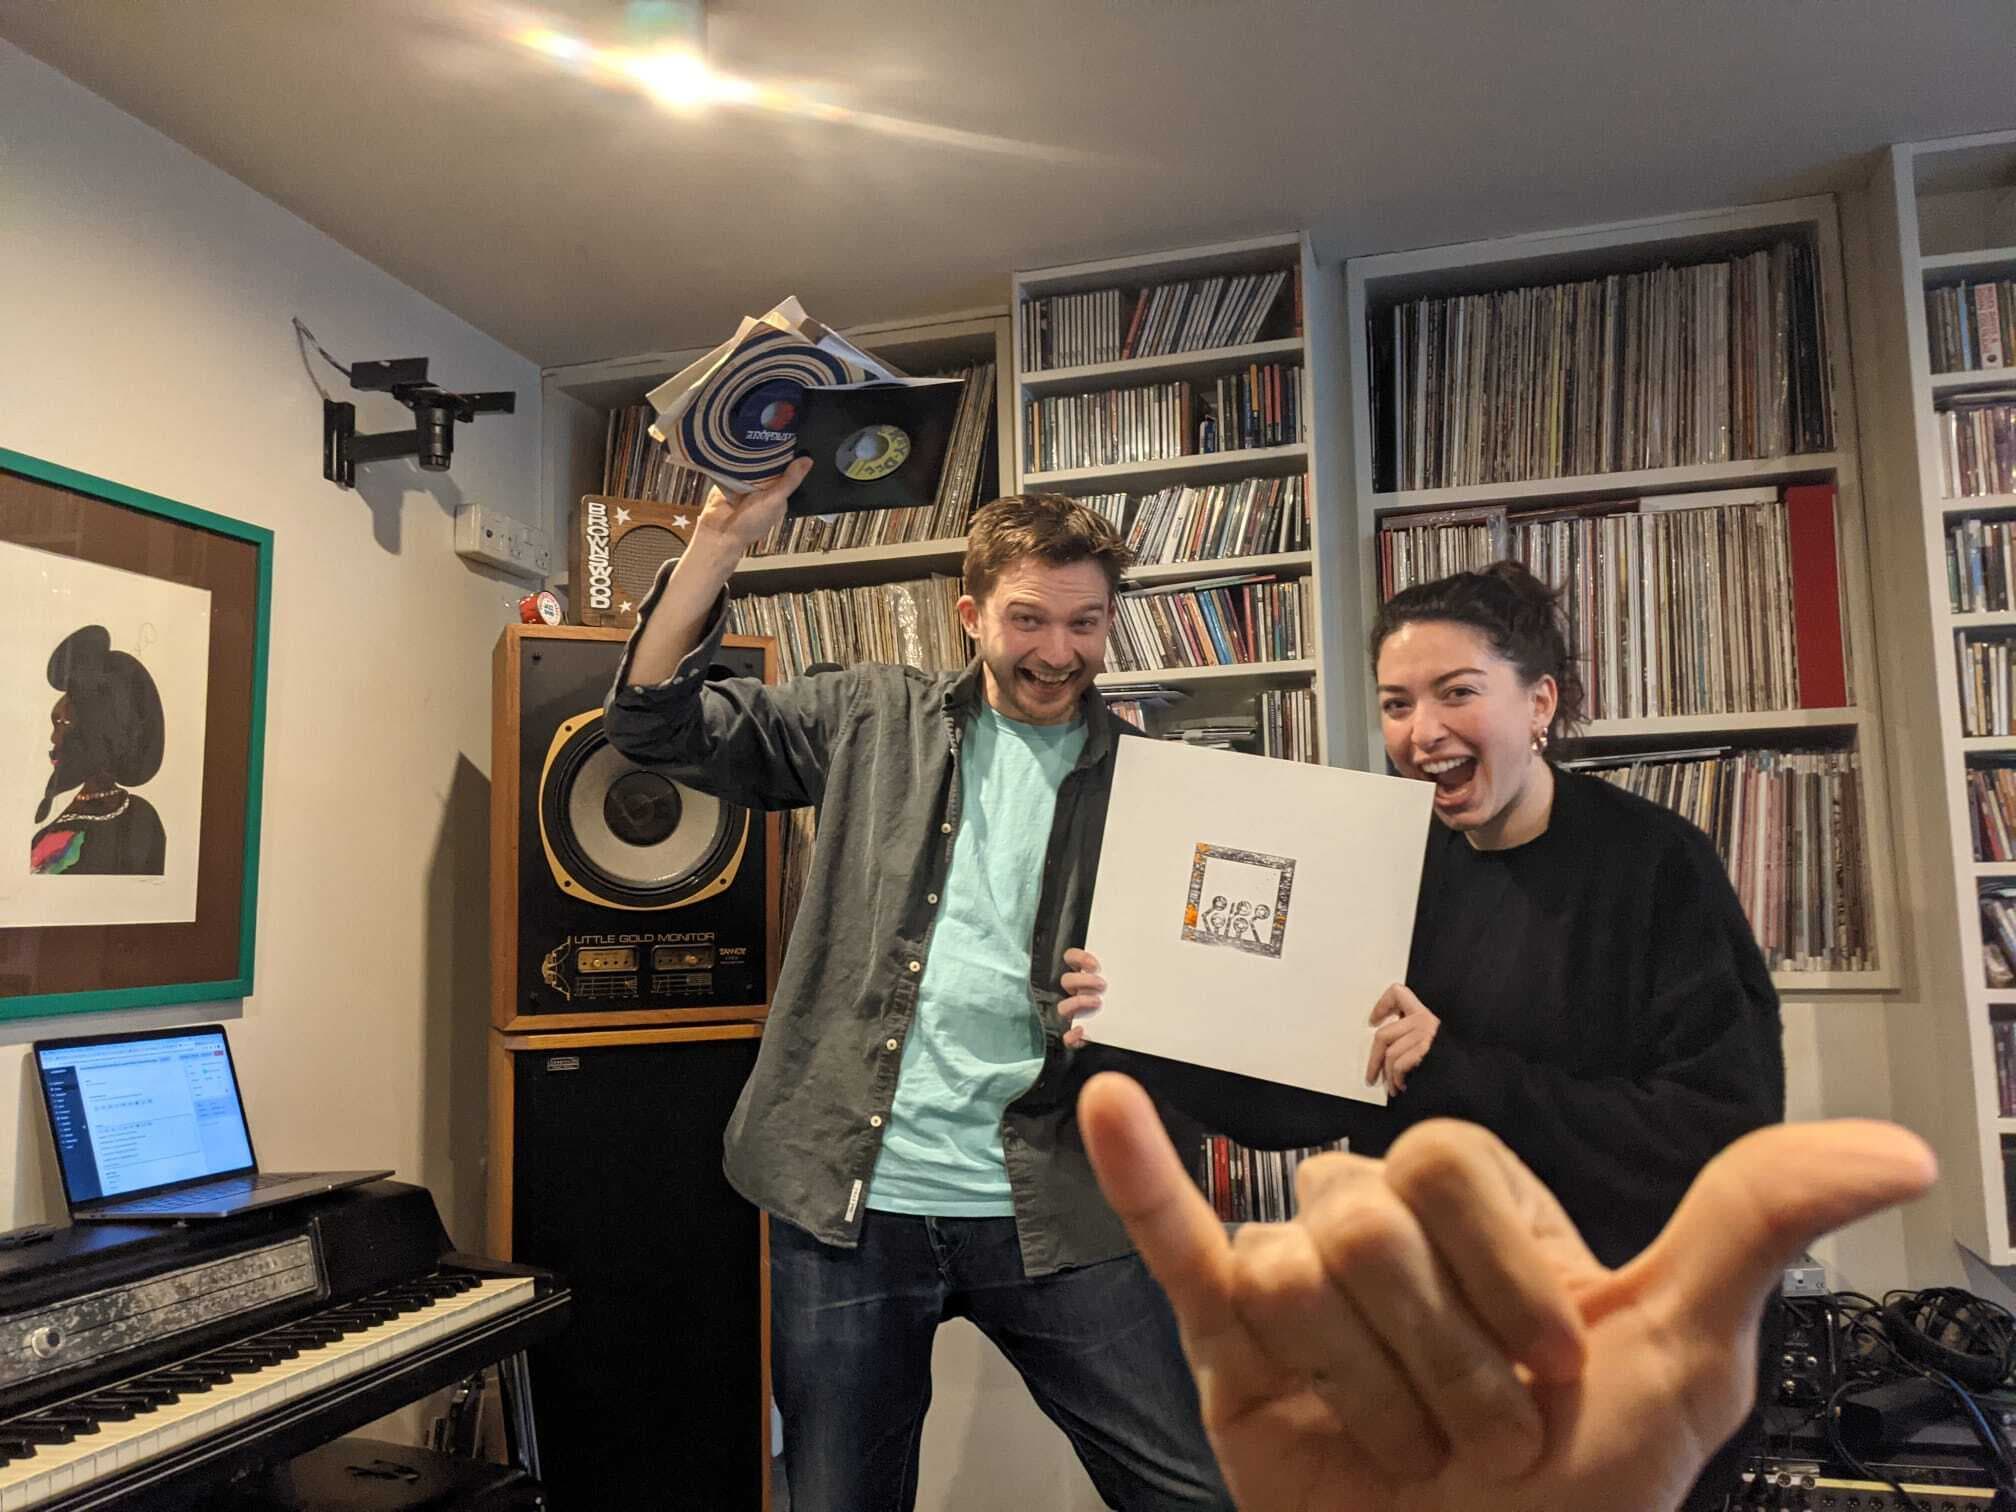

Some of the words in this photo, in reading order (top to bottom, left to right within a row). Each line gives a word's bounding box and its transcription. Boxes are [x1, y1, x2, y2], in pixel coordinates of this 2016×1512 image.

[586, 502, 613, 609] BROWNSWOOD
[574, 934, 615, 945] LITTLE
[619, 933, 654, 944] GOLD
[657, 931, 715, 942] MONITOR
